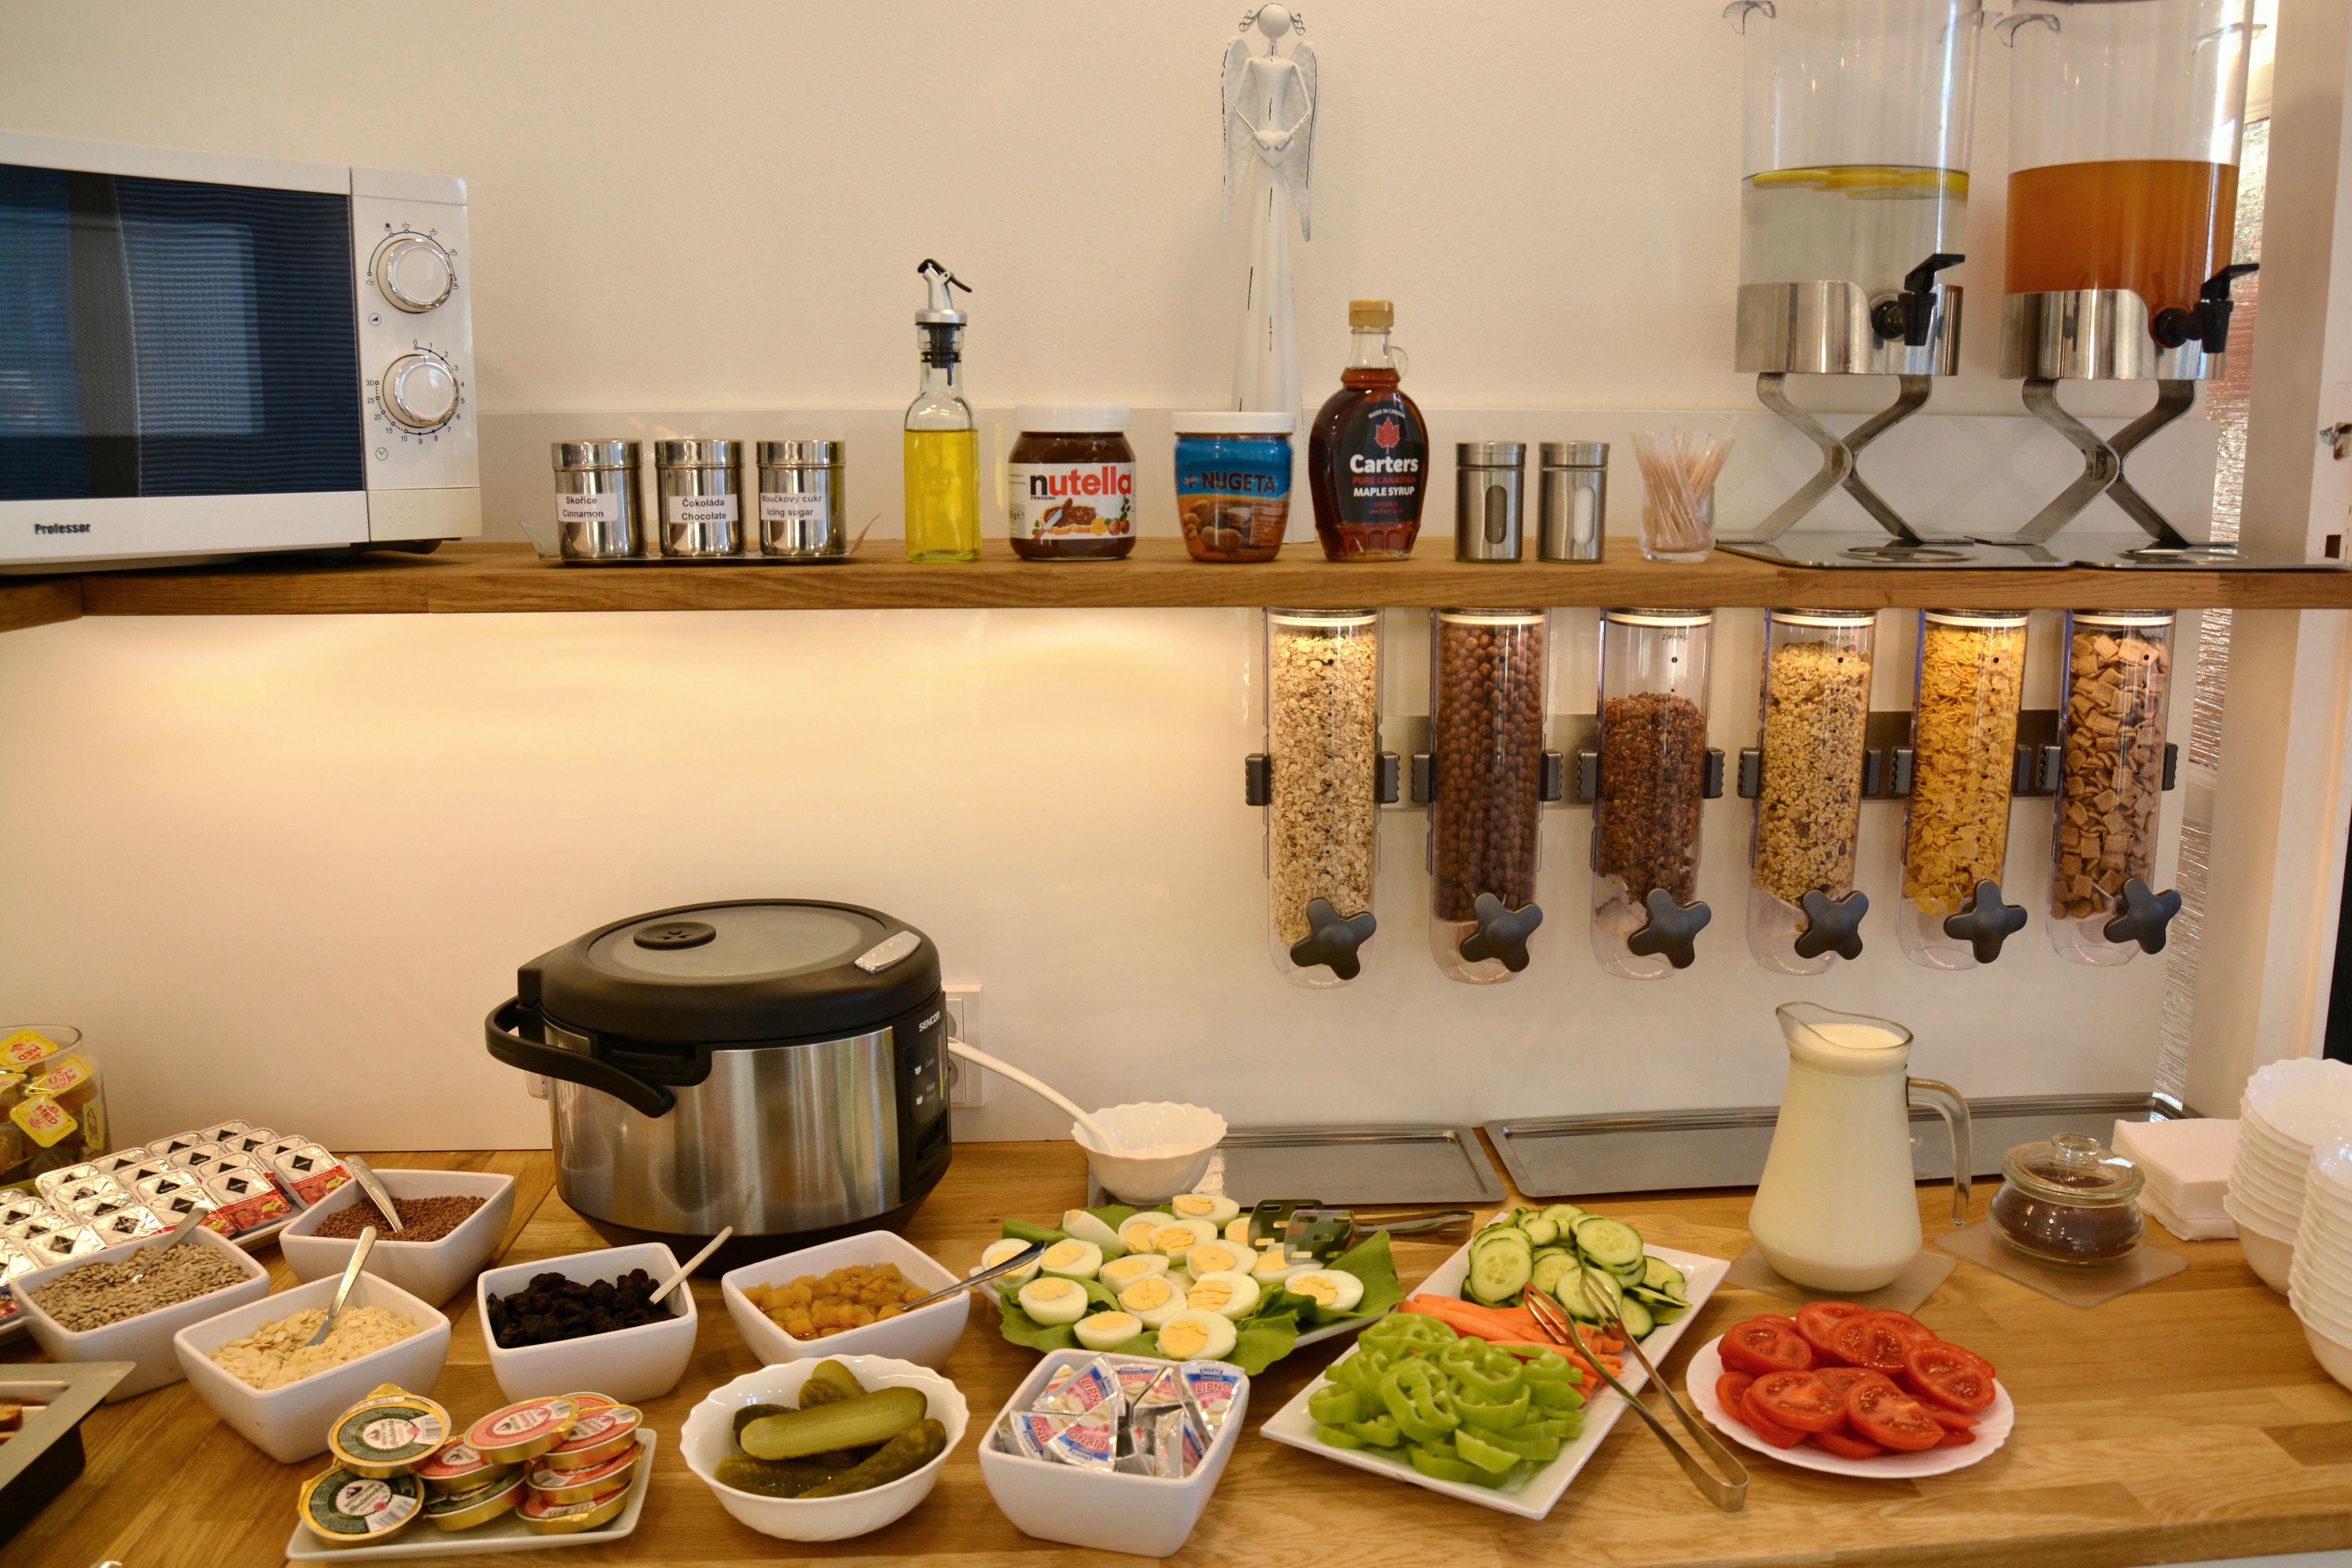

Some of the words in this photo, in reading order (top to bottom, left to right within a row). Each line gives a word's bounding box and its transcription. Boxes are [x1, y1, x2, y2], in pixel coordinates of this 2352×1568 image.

[1350, 454, 1419, 474] Carters
[1030, 466, 1132, 496] nutella
[1201, 471, 1277, 493] NUGETA
[1352, 476, 1376, 485] PURE
[1376, 475, 1417, 484] CANADIAN
[1354, 487, 1387, 497] MAPLE
[1387, 486, 1415, 497] SYRUP
[566, 496, 597, 505] Skořice
[682, 497, 725, 507] Čokoláda
[762, 494, 799, 504] Moučkový
[563, 509, 604, 518] Cinnamon
[682, 512, 727, 521] Chocolate
[767, 508, 785, 518] Icing
[788, 509, 813, 518] sugar
[35, 523, 91, 535] Professor
[919, 1011, 940, 1033] SENCOR
[18, 1045, 42, 1061] MED
[36, 1104, 59, 1125] MED
[1082, 1378, 1102, 1406] LIPN
[1196, 1382, 1232, 1393] LIPNO
[1068, 1431, 1107, 1450] LIPNO
